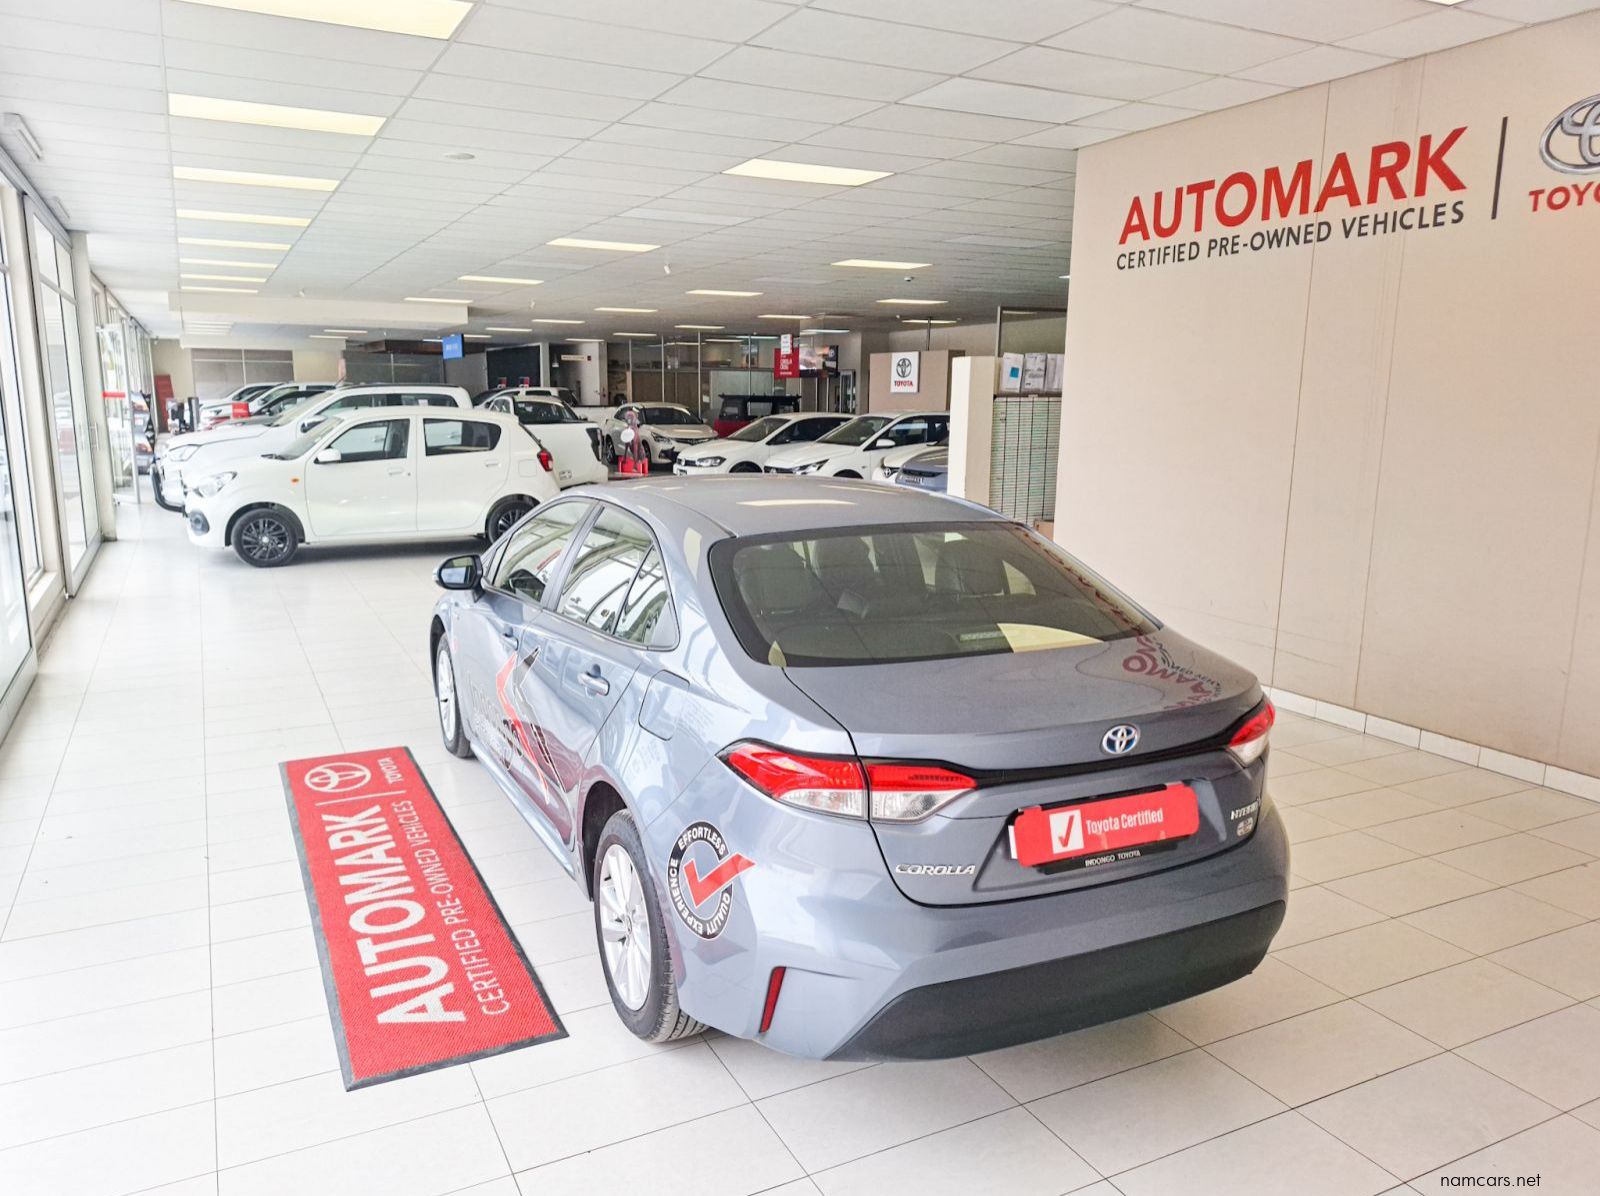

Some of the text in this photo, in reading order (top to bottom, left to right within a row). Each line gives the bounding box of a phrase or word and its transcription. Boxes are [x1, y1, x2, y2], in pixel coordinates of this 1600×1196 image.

[1118, 126, 1468, 245] AUTOMARK
[1528, 181, 1600, 212] TOY
[1116, 200, 1465, 271] CERTIFIED PRE-OWNED VEHICLES
[379, 757, 404, 785] TOYOTA
[1086, 807, 1164, 835] Toyota Certified
[677, 826, 726, 855] EFFORTLESS
[895, 864, 976, 876] COROLLA
[1085, 850, 1141, 867] INDONGO TOYOTA
[391, 799, 510, 1016] CERTIFIED PRE-OWNED VEHICLES
[669, 858, 730, 936] QUALITY EXPERIENCE
[321, 804, 467, 1024] AUTOMARK
